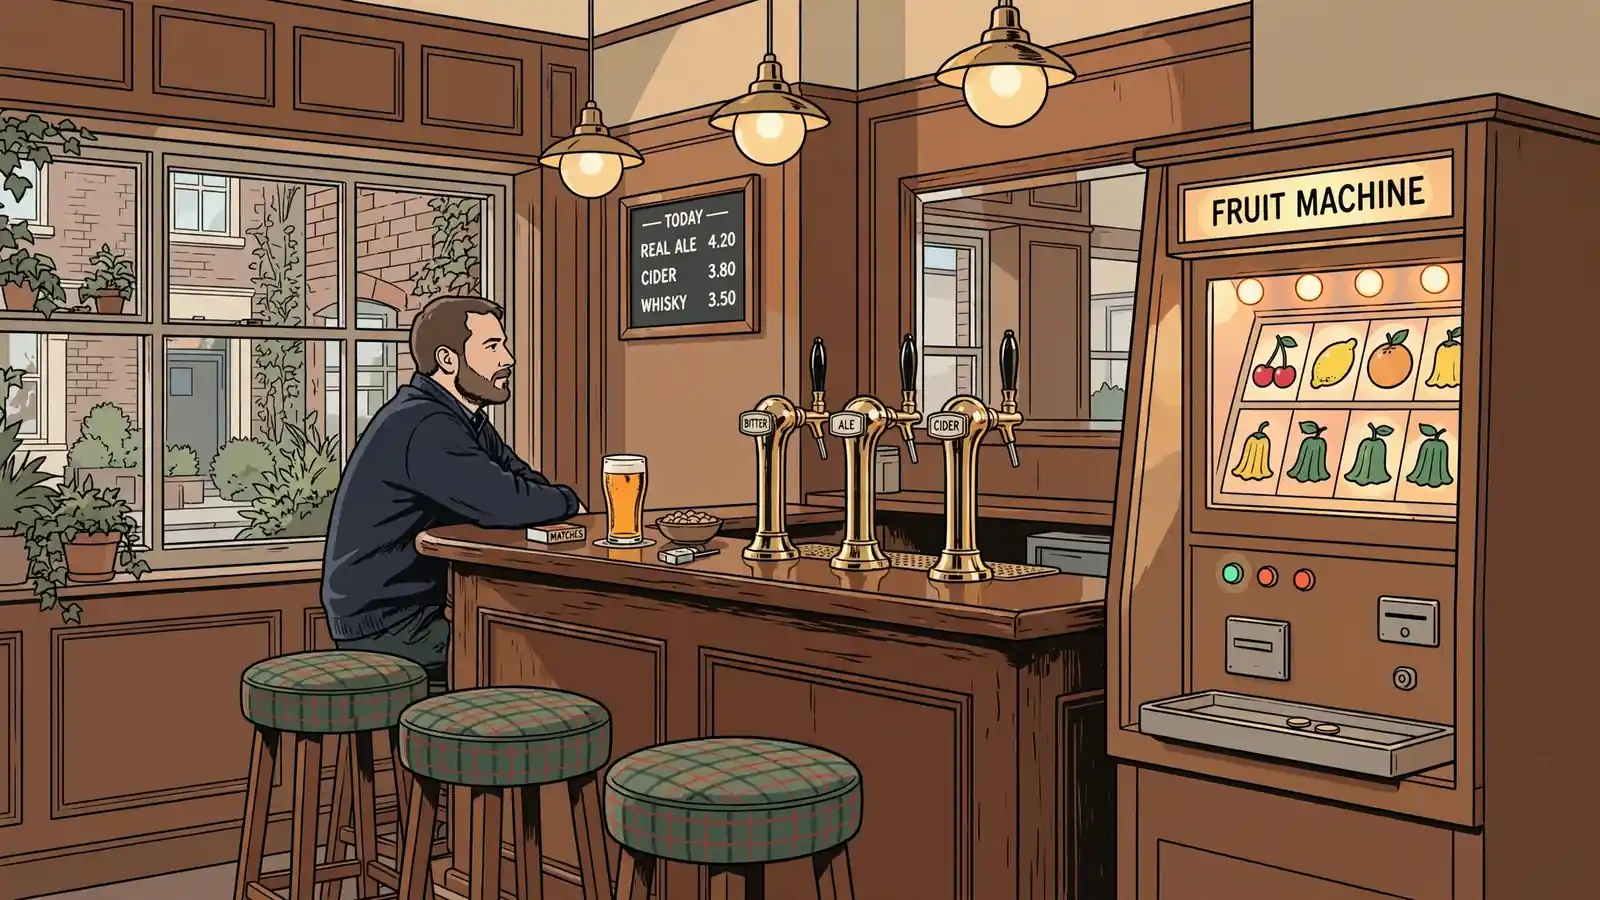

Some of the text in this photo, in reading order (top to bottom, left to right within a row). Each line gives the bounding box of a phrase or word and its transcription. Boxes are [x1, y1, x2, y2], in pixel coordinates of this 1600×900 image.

[1212, 175, 1425, 227] FRUIT MACHINE
[664, 209, 704, 228] TODAY
[640, 231, 736, 258] REAL ALE 4.20
[641, 261, 736, 285] CIDER 3.80
[641, 290, 736, 313] WHISKY 3.50
[744, 418, 768, 429] BITTER
[838, 419, 855, 430] ALE
[933, 420, 960, 432] CIDER
[550, 529, 584, 542] MATCHES
